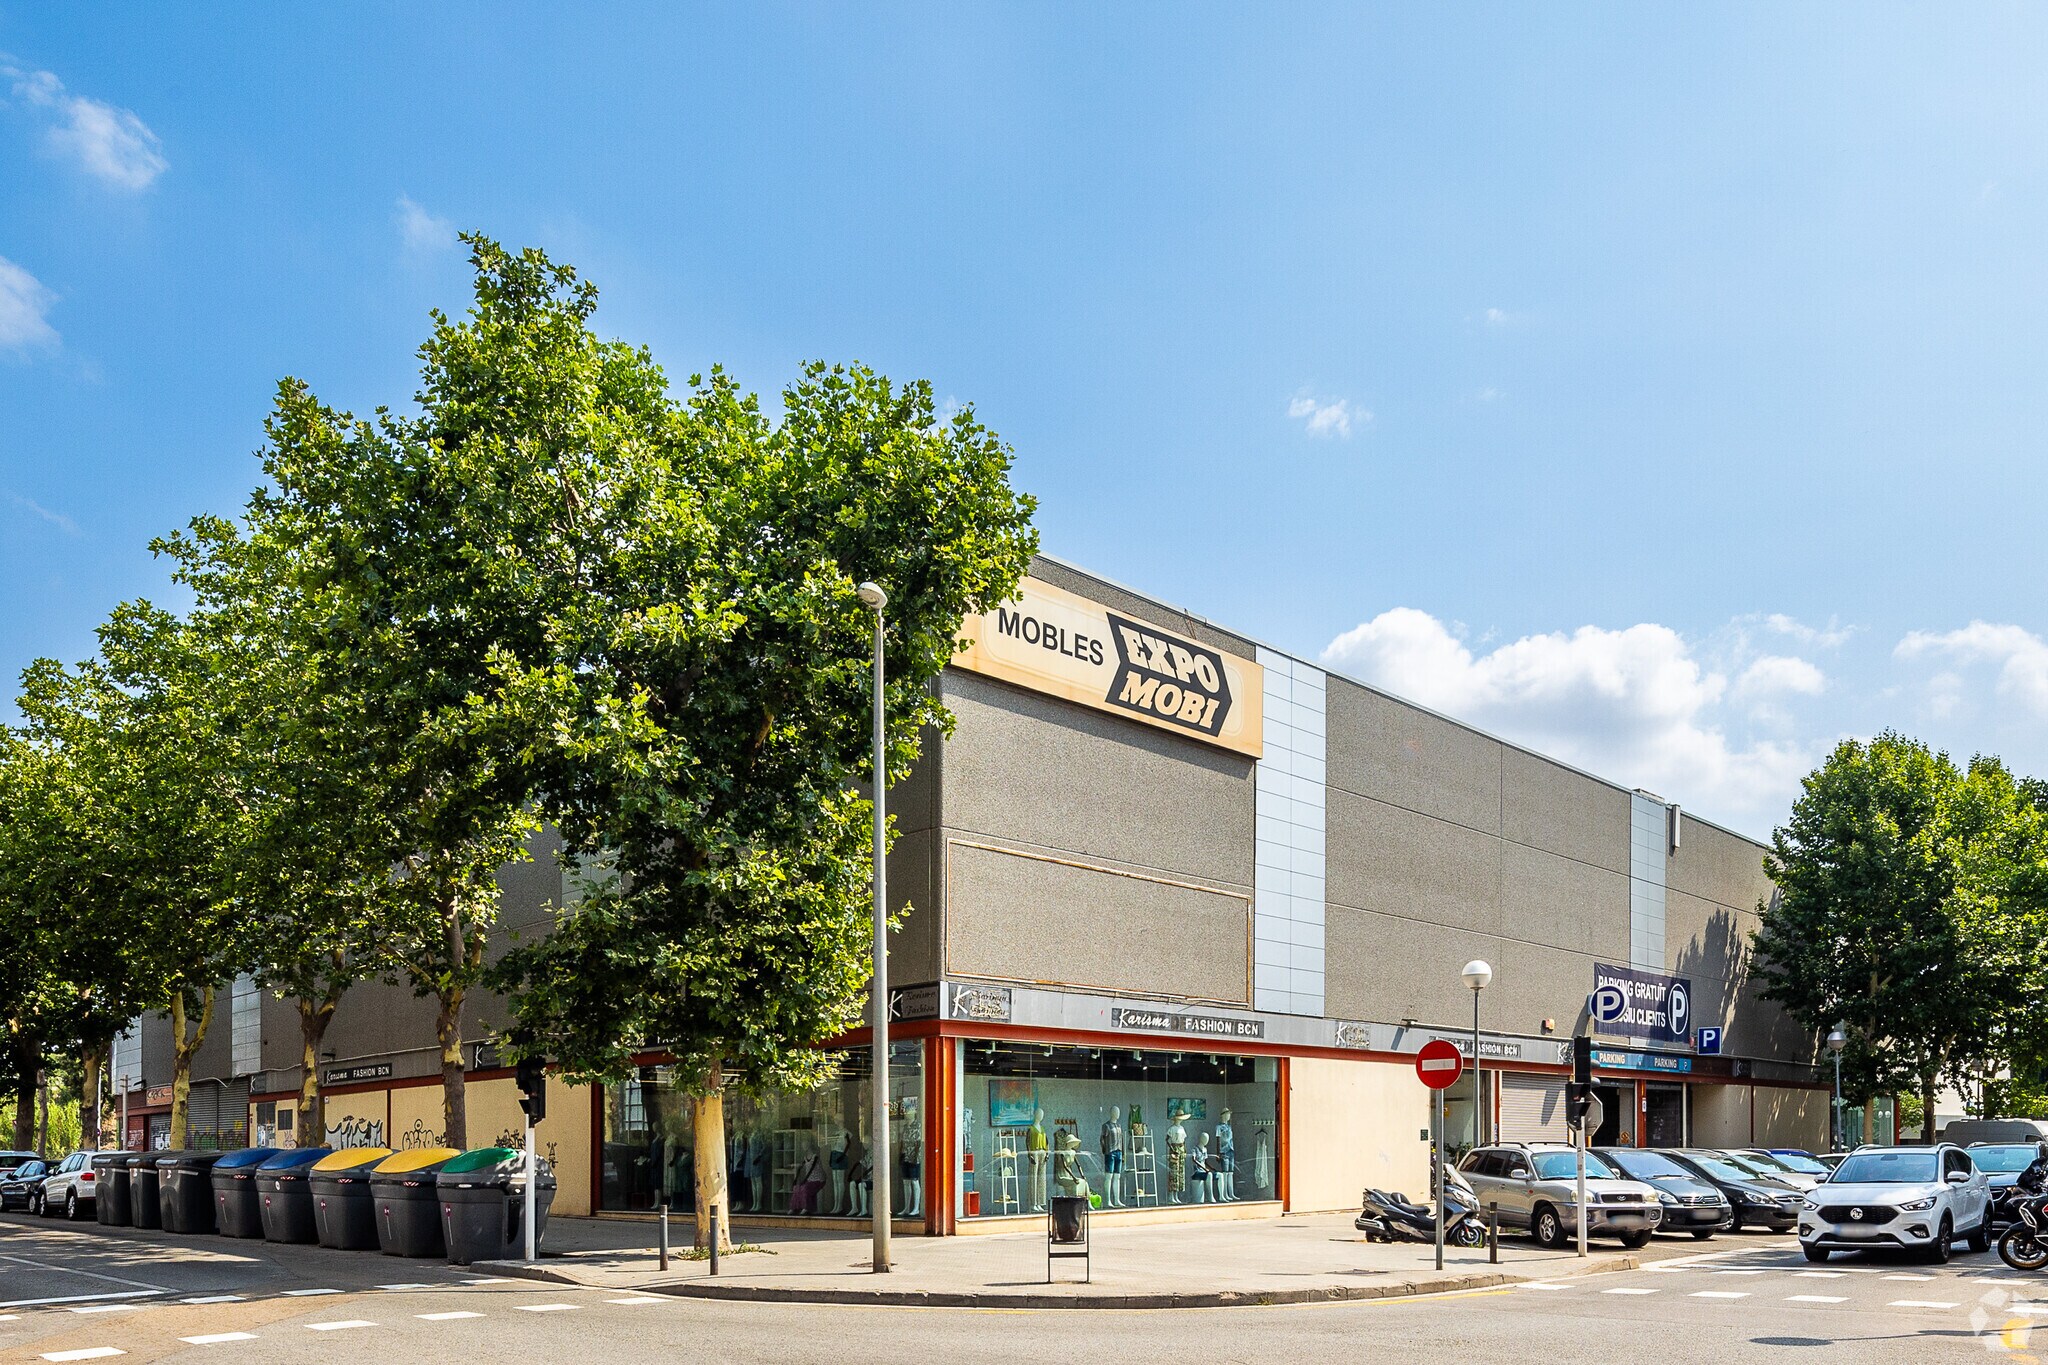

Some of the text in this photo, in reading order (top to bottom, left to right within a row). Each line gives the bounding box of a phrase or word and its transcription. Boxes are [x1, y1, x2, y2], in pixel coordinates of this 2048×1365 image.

[998, 607, 1104, 666] MOBLES
[1118, 624, 1220, 694] EXPO
[1118, 671, 1219, 729] MOBI
[1118, 1008, 1259, 1036] Karisma FASHION BCN
[1636, 1008, 1666, 1028] CLIENTS
[1599, 1052, 1626, 1064] PARKING
[1654, 1057, 1677, 1069] PARKING
[353, 1067, 376, 1078] FASHION
[378, 1066, 390, 1076] BCN
